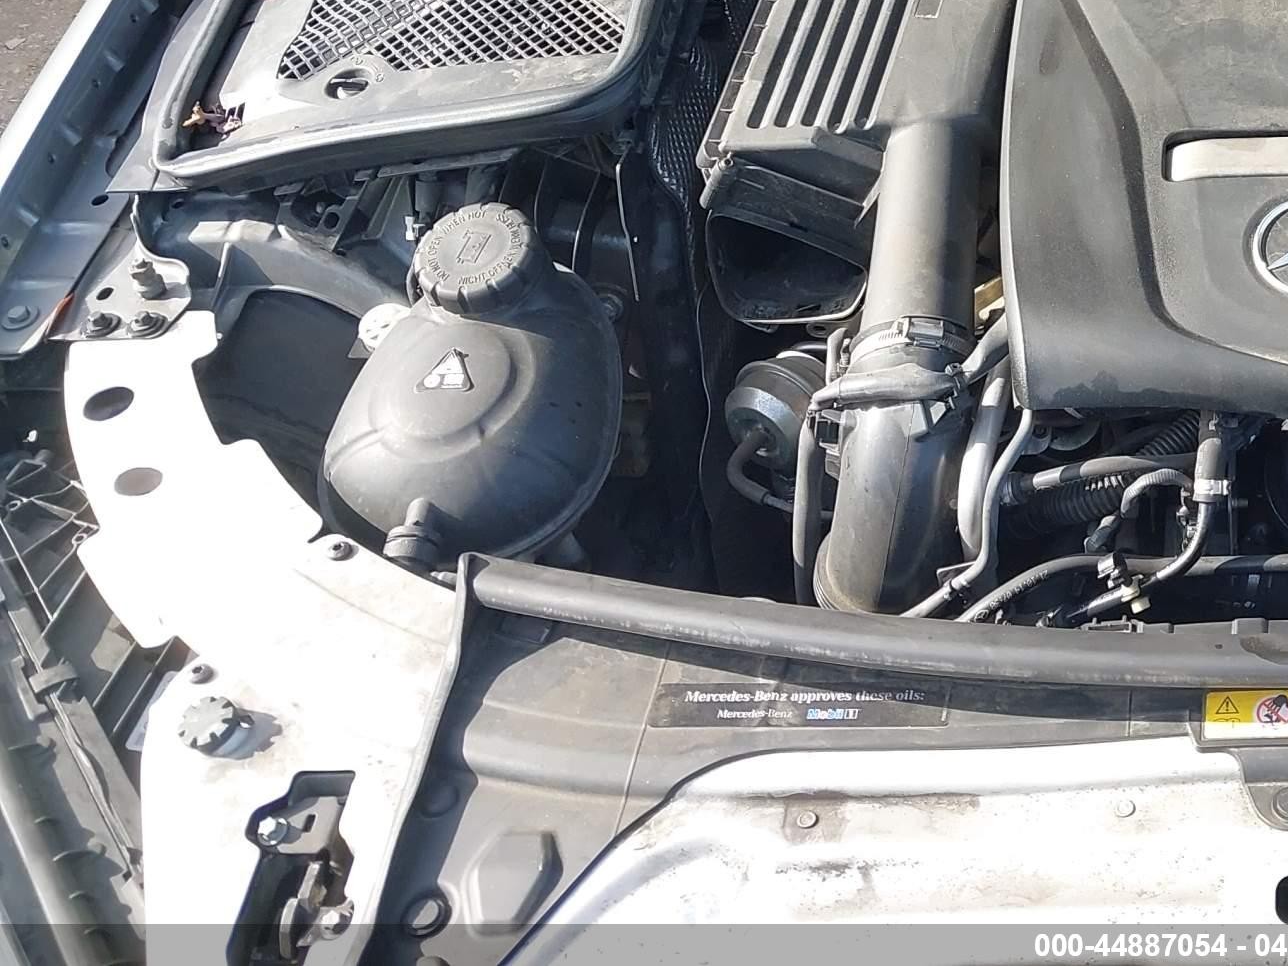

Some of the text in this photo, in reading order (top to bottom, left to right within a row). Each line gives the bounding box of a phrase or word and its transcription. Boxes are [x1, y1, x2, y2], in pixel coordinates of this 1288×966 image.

[684, 689, 925, 704] Mercedes-Benz approves these oils:
[716, 708, 793, 719] Mercedes-Benz
